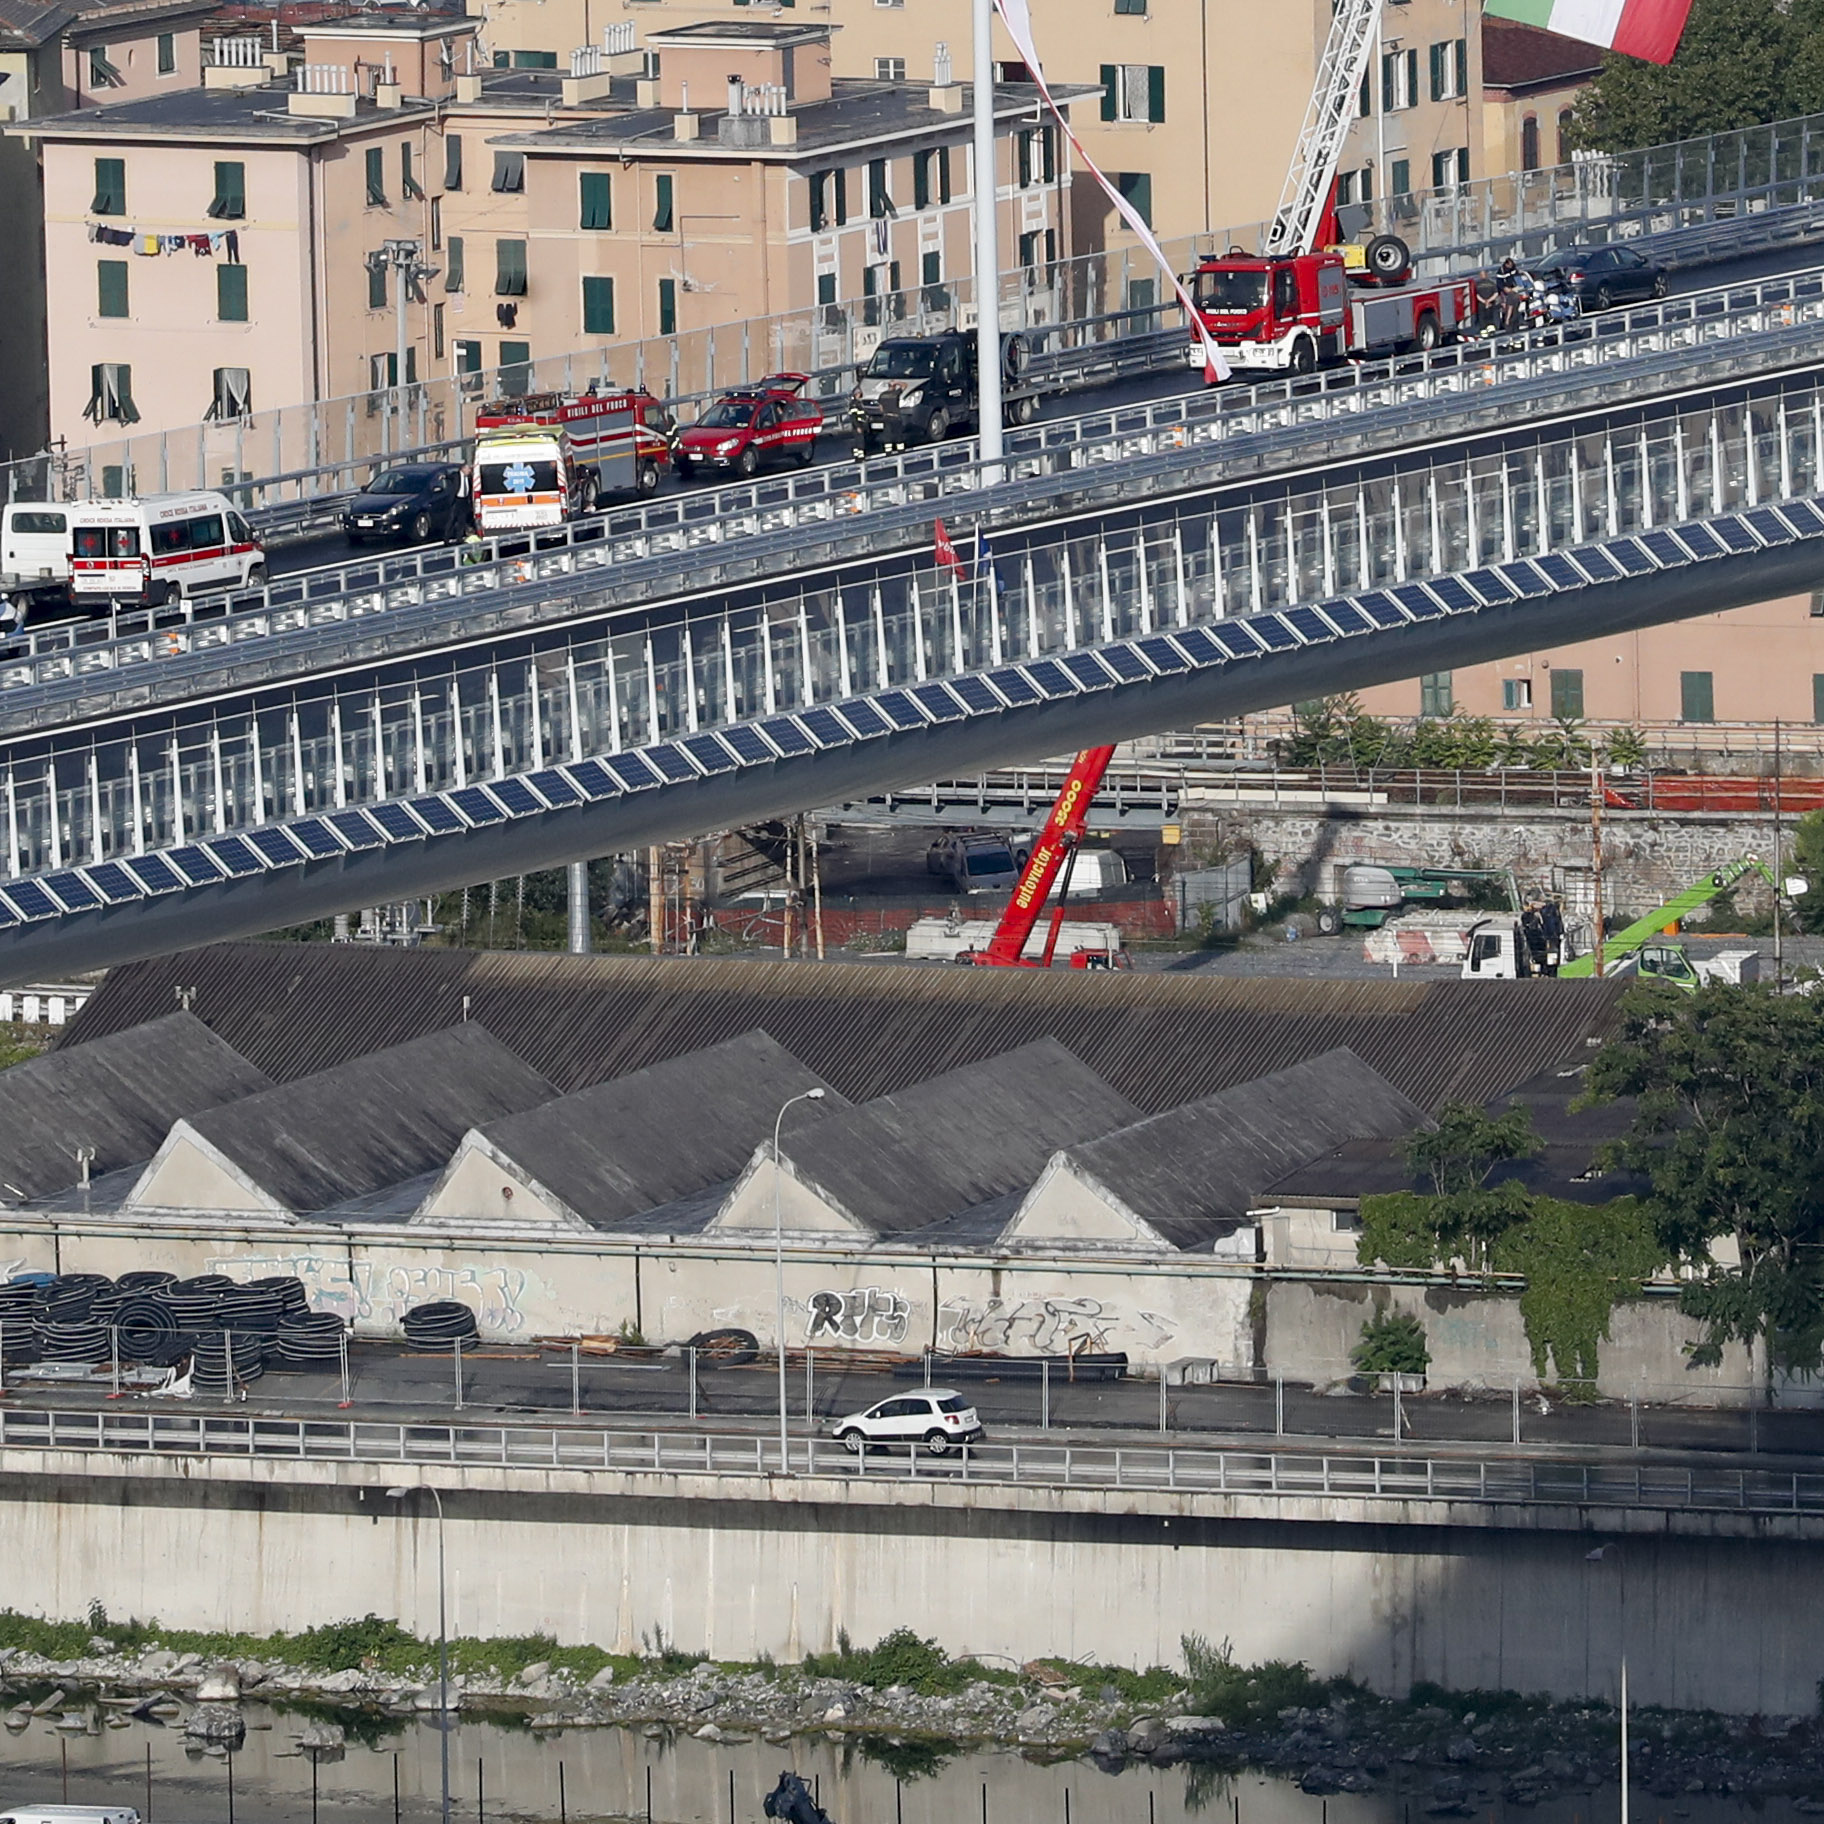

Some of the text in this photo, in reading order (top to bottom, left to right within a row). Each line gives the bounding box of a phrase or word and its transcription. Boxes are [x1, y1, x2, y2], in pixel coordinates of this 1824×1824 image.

[567, 398, 628, 419] VIGILI DEL FUOCO
[1055, 779, 1082, 827] 35000
[1016, 845, 1053, 909] autovictor
